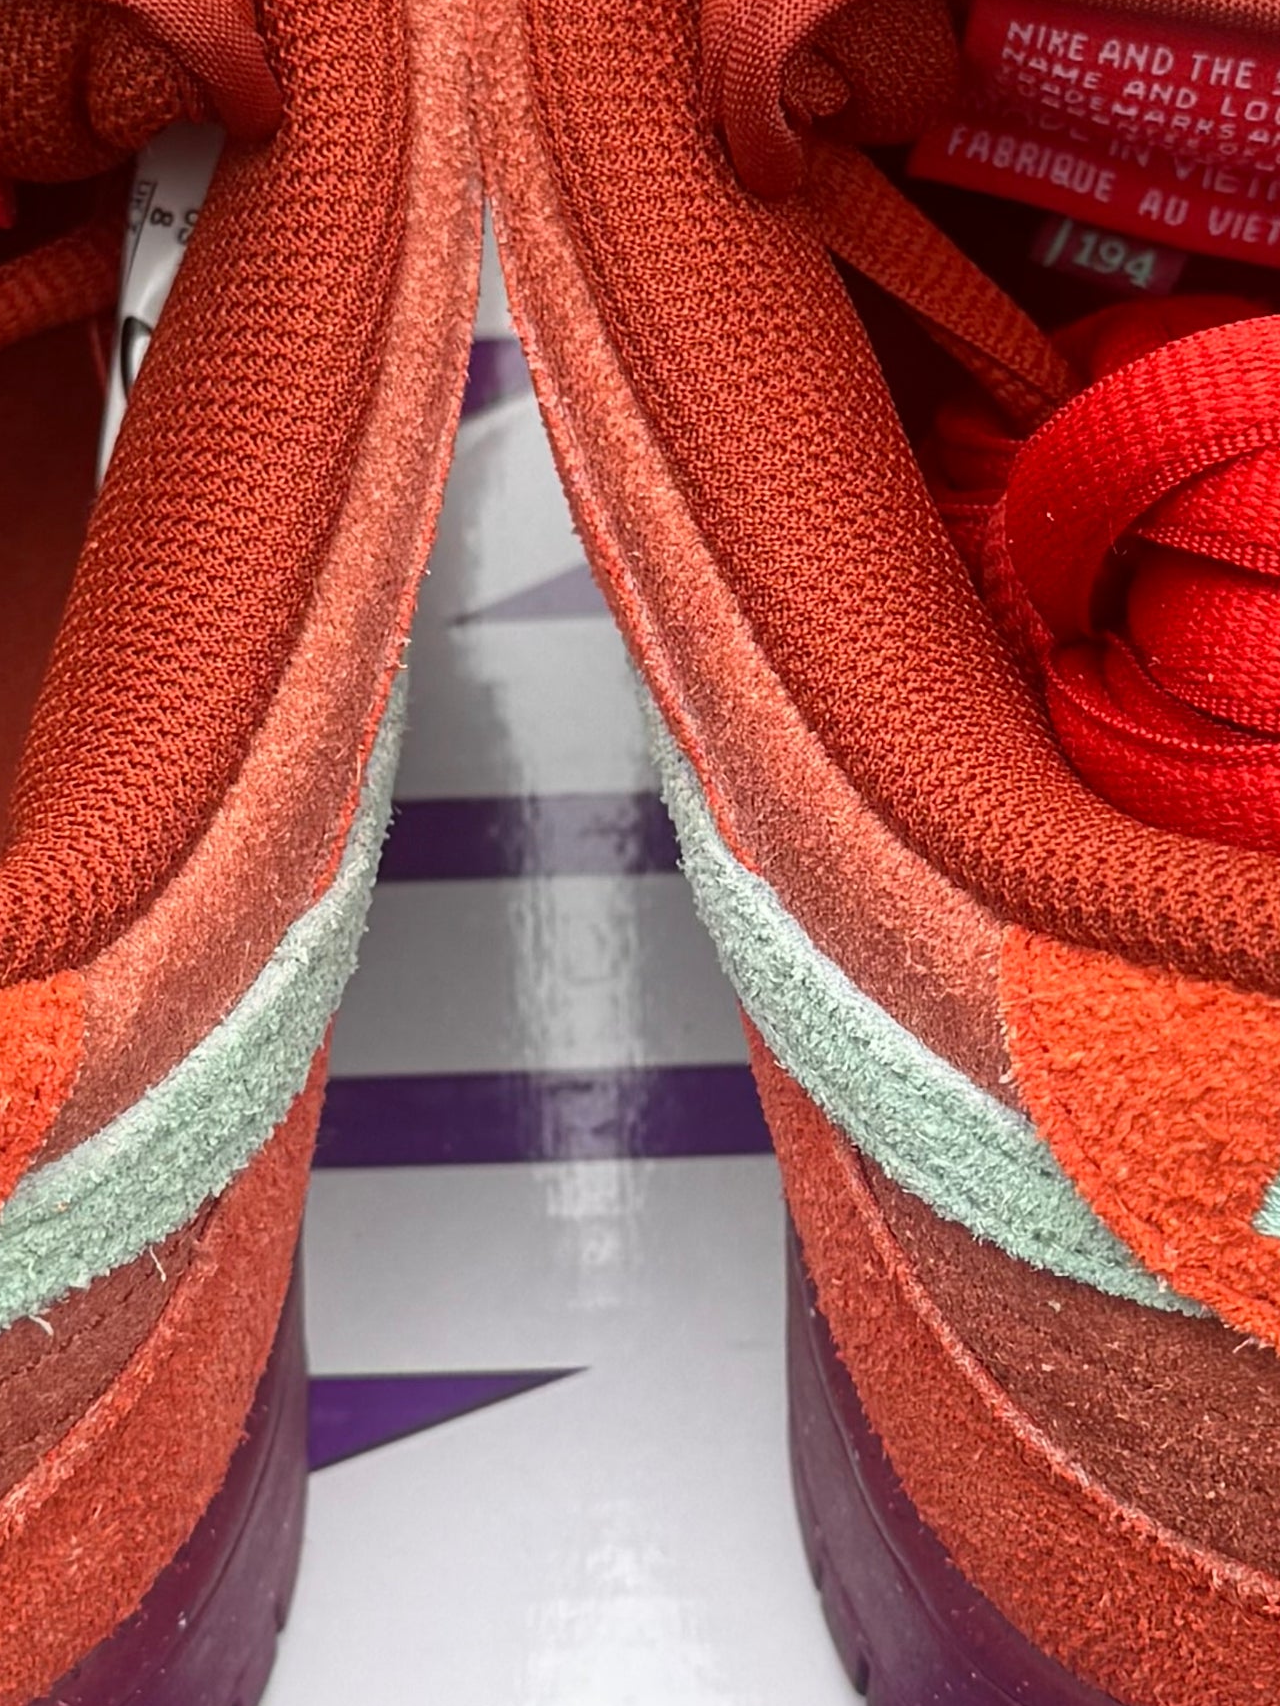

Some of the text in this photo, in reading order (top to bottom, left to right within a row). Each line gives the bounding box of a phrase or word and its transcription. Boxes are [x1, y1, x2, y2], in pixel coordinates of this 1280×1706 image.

[1001, 47, 1103, 90] NAME
[1123, 79, 1200, 119] AND
[1006, 21, 1089, 62] NIKE
[1096, 38, 1174, 77] AND
[1190, 53, 1256, 89] THE
[947, 125, 1118, 204] FABRIQUE
[1138, 187, 1190, 227] AU
